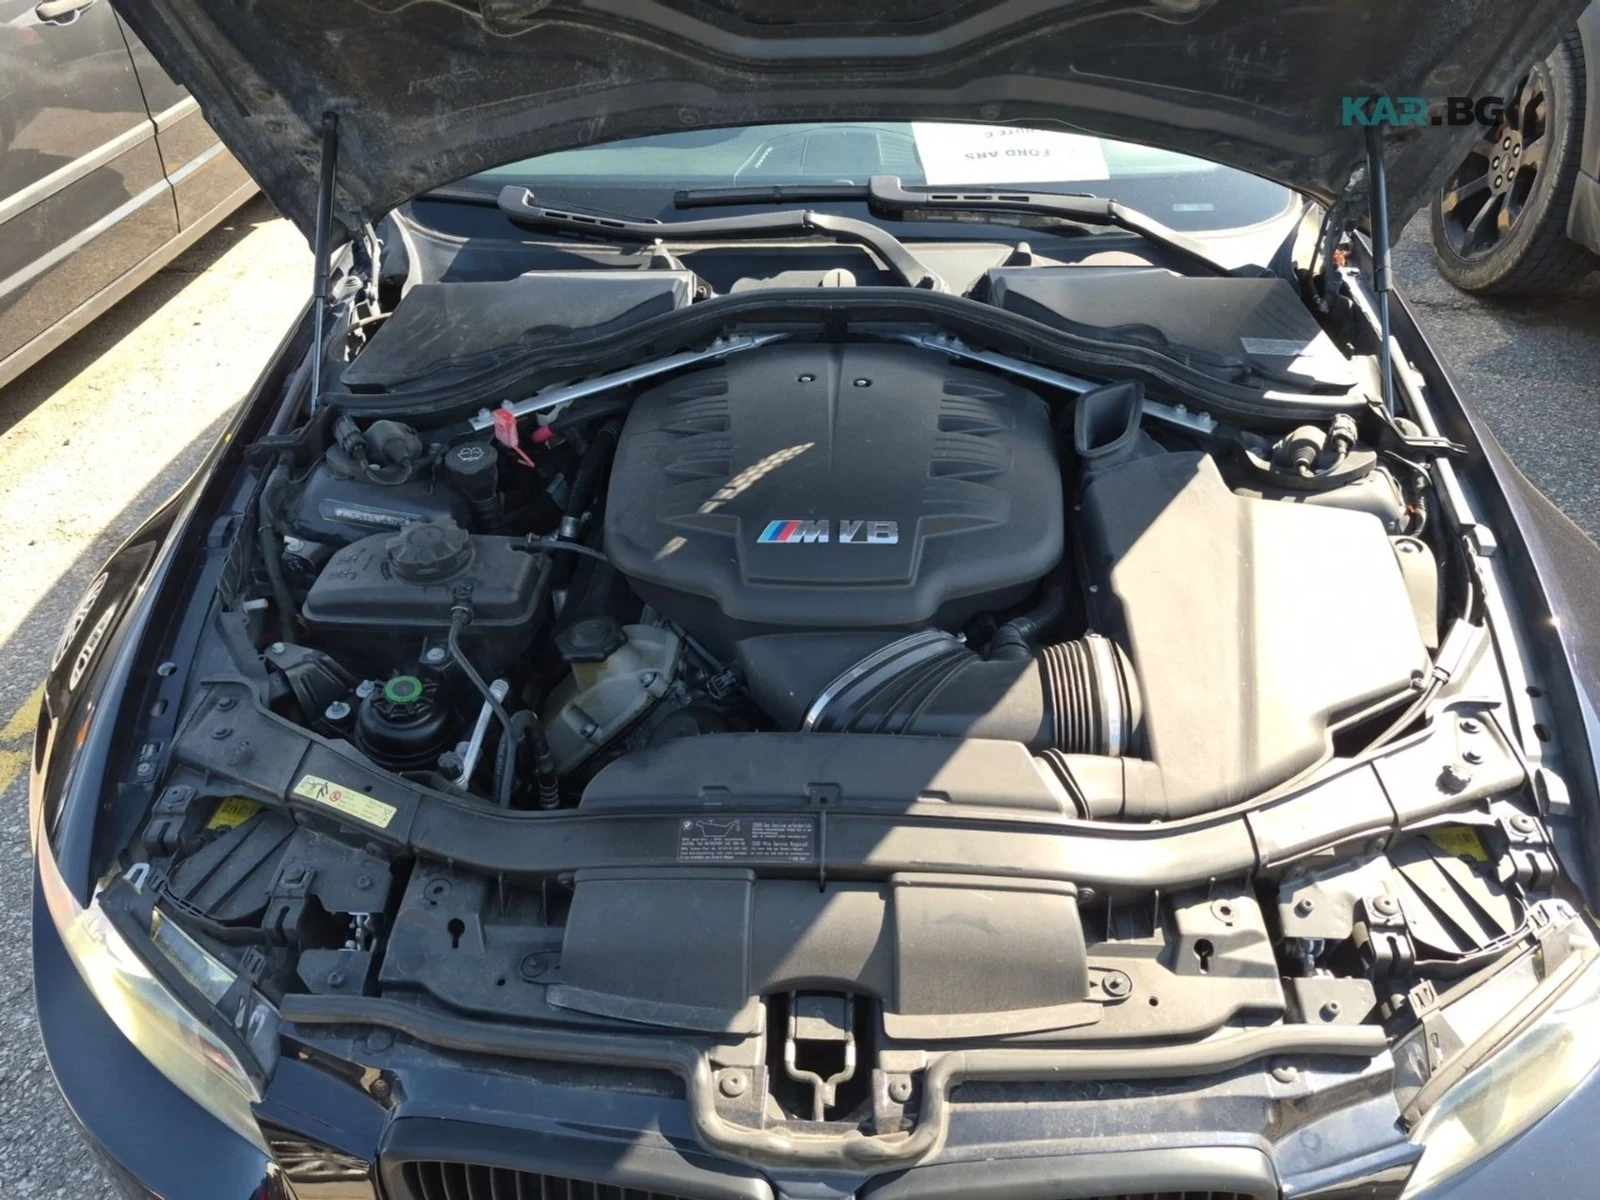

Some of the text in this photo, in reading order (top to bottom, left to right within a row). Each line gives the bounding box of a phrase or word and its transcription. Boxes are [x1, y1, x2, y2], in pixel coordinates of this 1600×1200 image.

[1004, 148, 1051, 157] FORD
[786, 520, 899, 544] M V8
